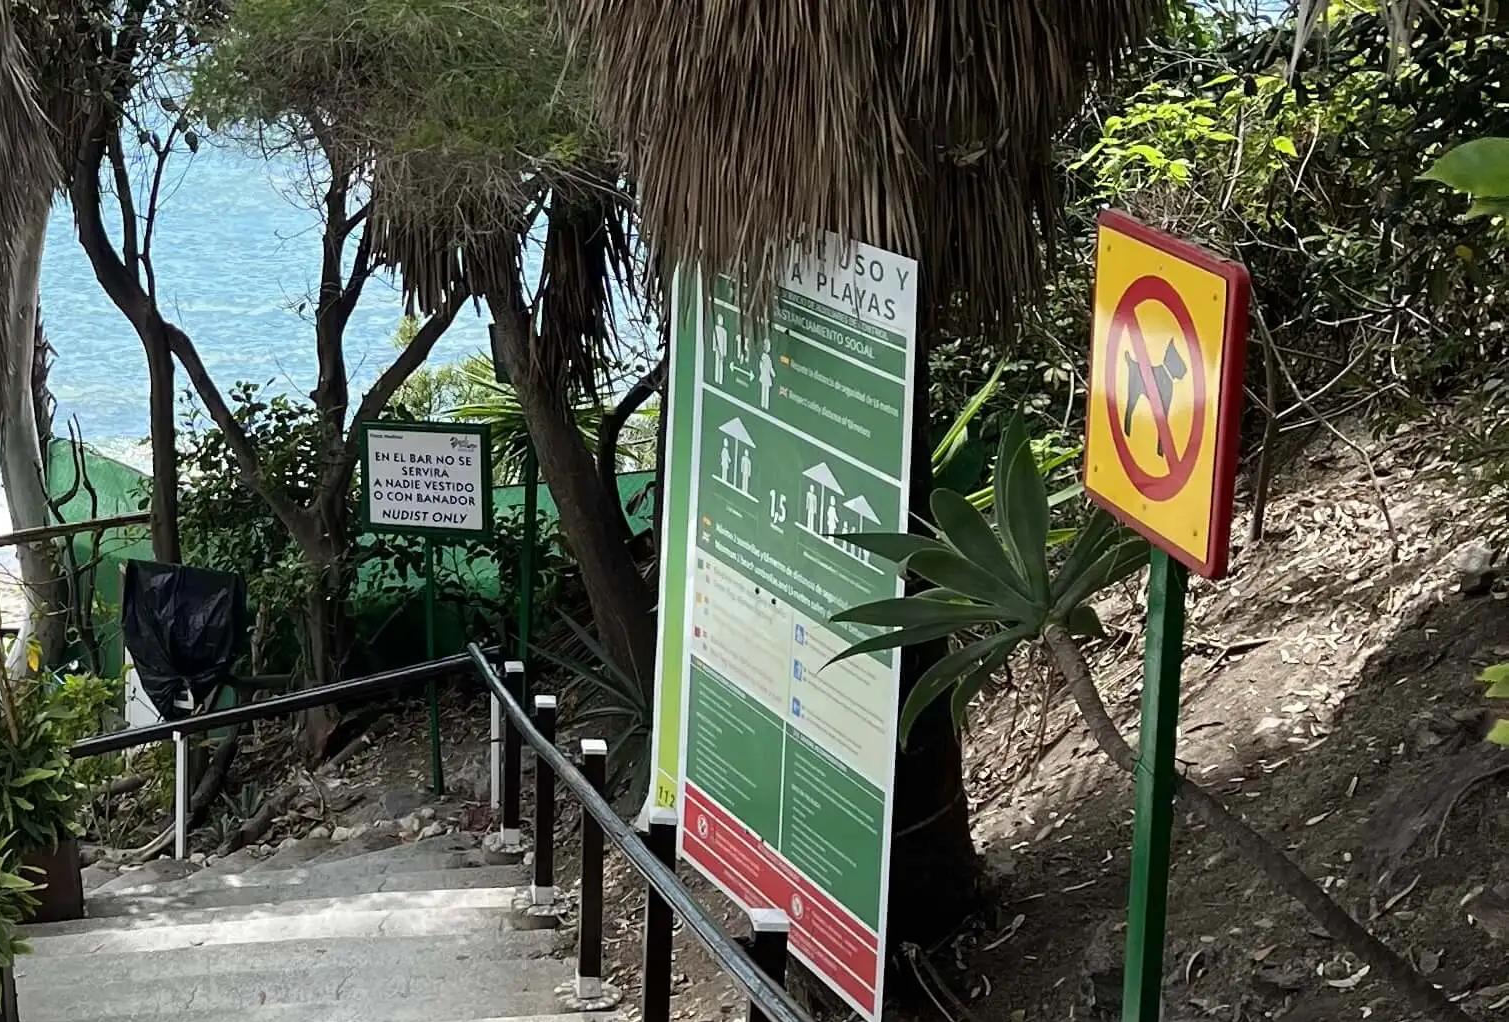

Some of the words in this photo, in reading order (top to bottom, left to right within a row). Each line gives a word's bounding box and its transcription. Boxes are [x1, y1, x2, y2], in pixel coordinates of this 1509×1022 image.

[896, 267, 909, 291] Y
[817, 271, 896, 321] PLAYAS
[844, 335, 876, 359] SOCIAL
[375, 451, 389, 462] EN
[394, 452, 406, 463] EL
[410, 454, 432, 465] BAR
[436, 455, 454, 466] NO
[459, 456, 472, 466] SE
[401, 466, 449, 478] SERVIRA
[373, 478, 382, 488] A
[385, 479, 421, 489] NADIE
[424, 481, 474, 493] VESTIDO
[373, 490, 383, 500] O
[387, 491, 412, 502] CON
[416, 493, 476, 506] BANADOR
[770, 489, 786, 523] 1,5
[382, 509, 429, 521] NUDIST
[432, 512, 468, 524] ONLY
[658, 785, 676, 808] 112
